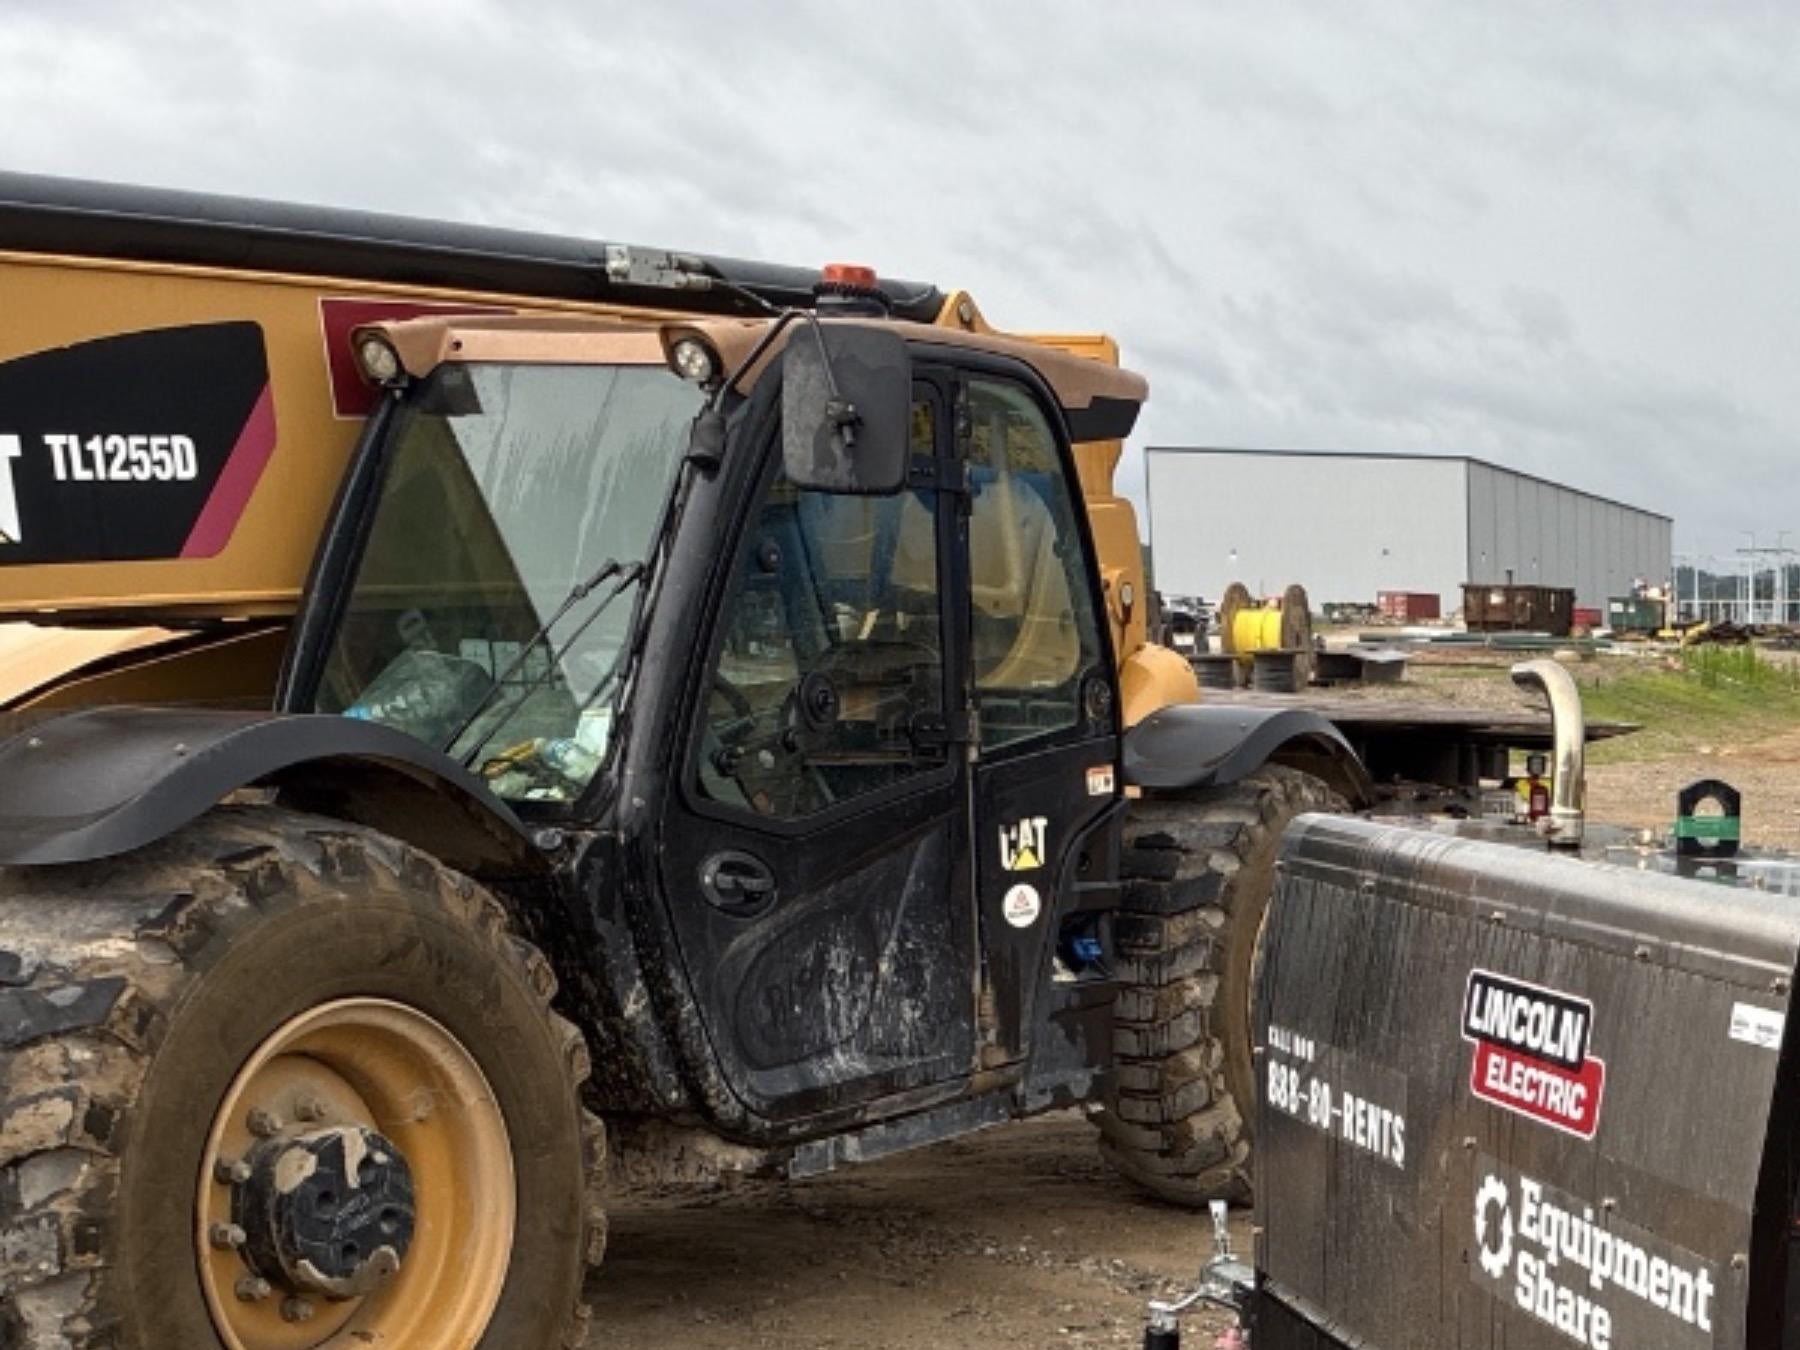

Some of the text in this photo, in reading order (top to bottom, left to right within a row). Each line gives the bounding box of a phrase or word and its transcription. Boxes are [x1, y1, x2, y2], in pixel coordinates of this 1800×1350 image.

[42, 434, 199, 481] TL1255D
[1468, 982, 1585, 1063] LINCOLN
[1484, 1054, 1588, 1122] ELECTRIC
[1518, 1175, 1715, 1334] Equipment
